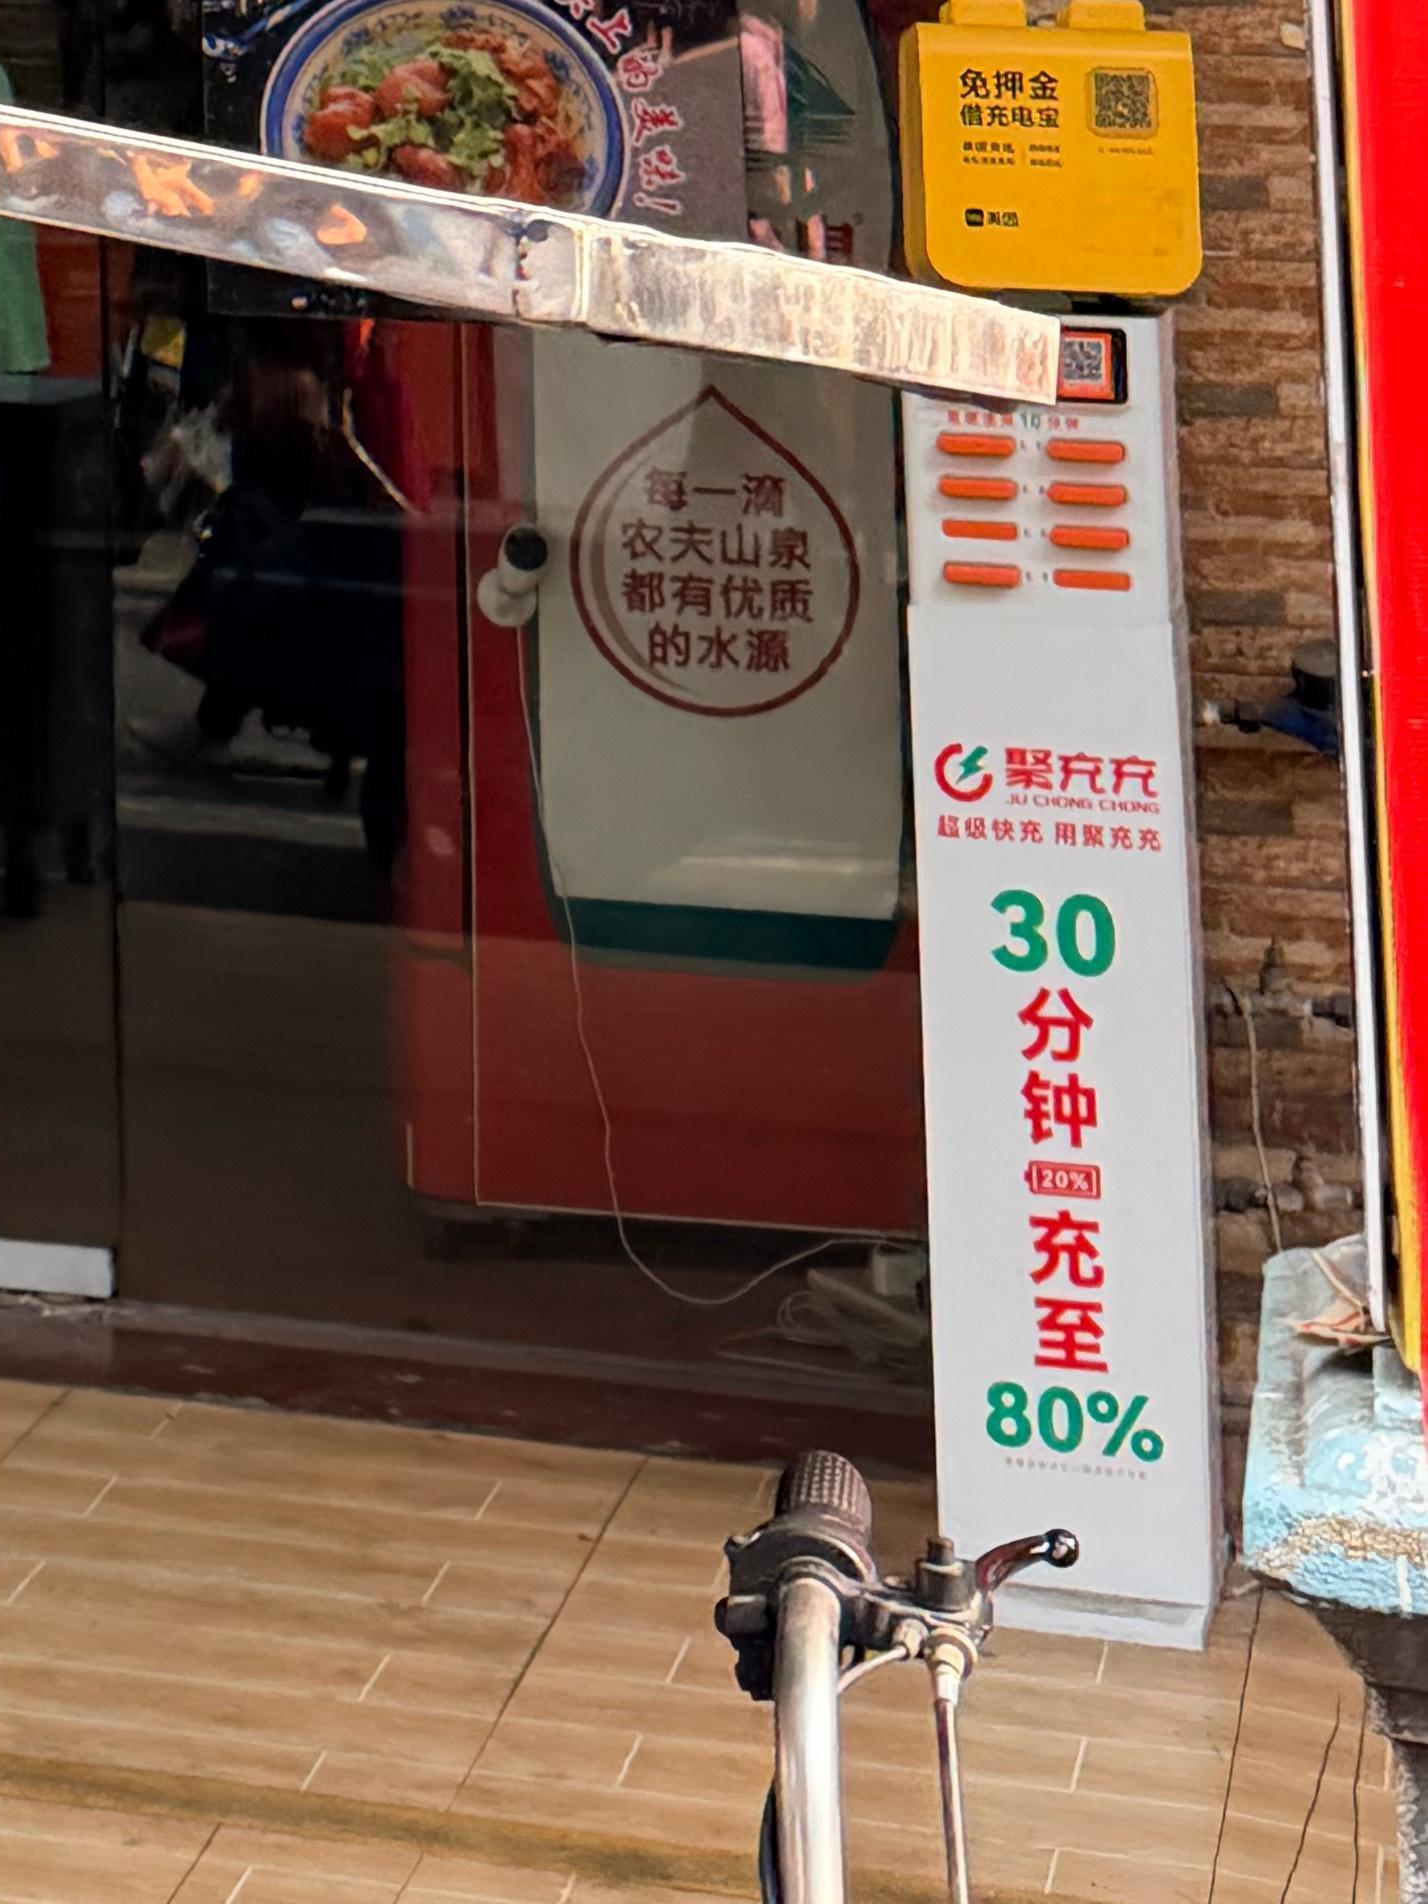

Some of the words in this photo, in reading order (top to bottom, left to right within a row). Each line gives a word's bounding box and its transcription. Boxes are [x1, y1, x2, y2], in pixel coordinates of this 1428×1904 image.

[959, 68, 1059, 101] 免押金
[960, 103, 1060, 129] 借充电宝
[646, 468, 786, 517] 每一滴
[622, 518, 811, 571] 农夫山泉
[622, 568, 814, 623] 都有优质
[649, 621, 789, 673] 的水源
[1005, 748, 1159, 798] 聚充充
[1006, 794, 1028, 806] JU
[1033, 795, 1093, 810] CHONG
[1099, 798, 1161, 814] CHONG
[937, 814, 1043, 844] 超级快充
[1054, 821, 1162, 853] 用聚充充
[991, 889, 1116, 978] 30
[1018, 988, 1098, 1149] 分钟
[1041, 1168, 1089, 1191] 20%
[1030, 1211, 1110, 1374] 充至
[986, 1381, 1165, 1464] 80%
